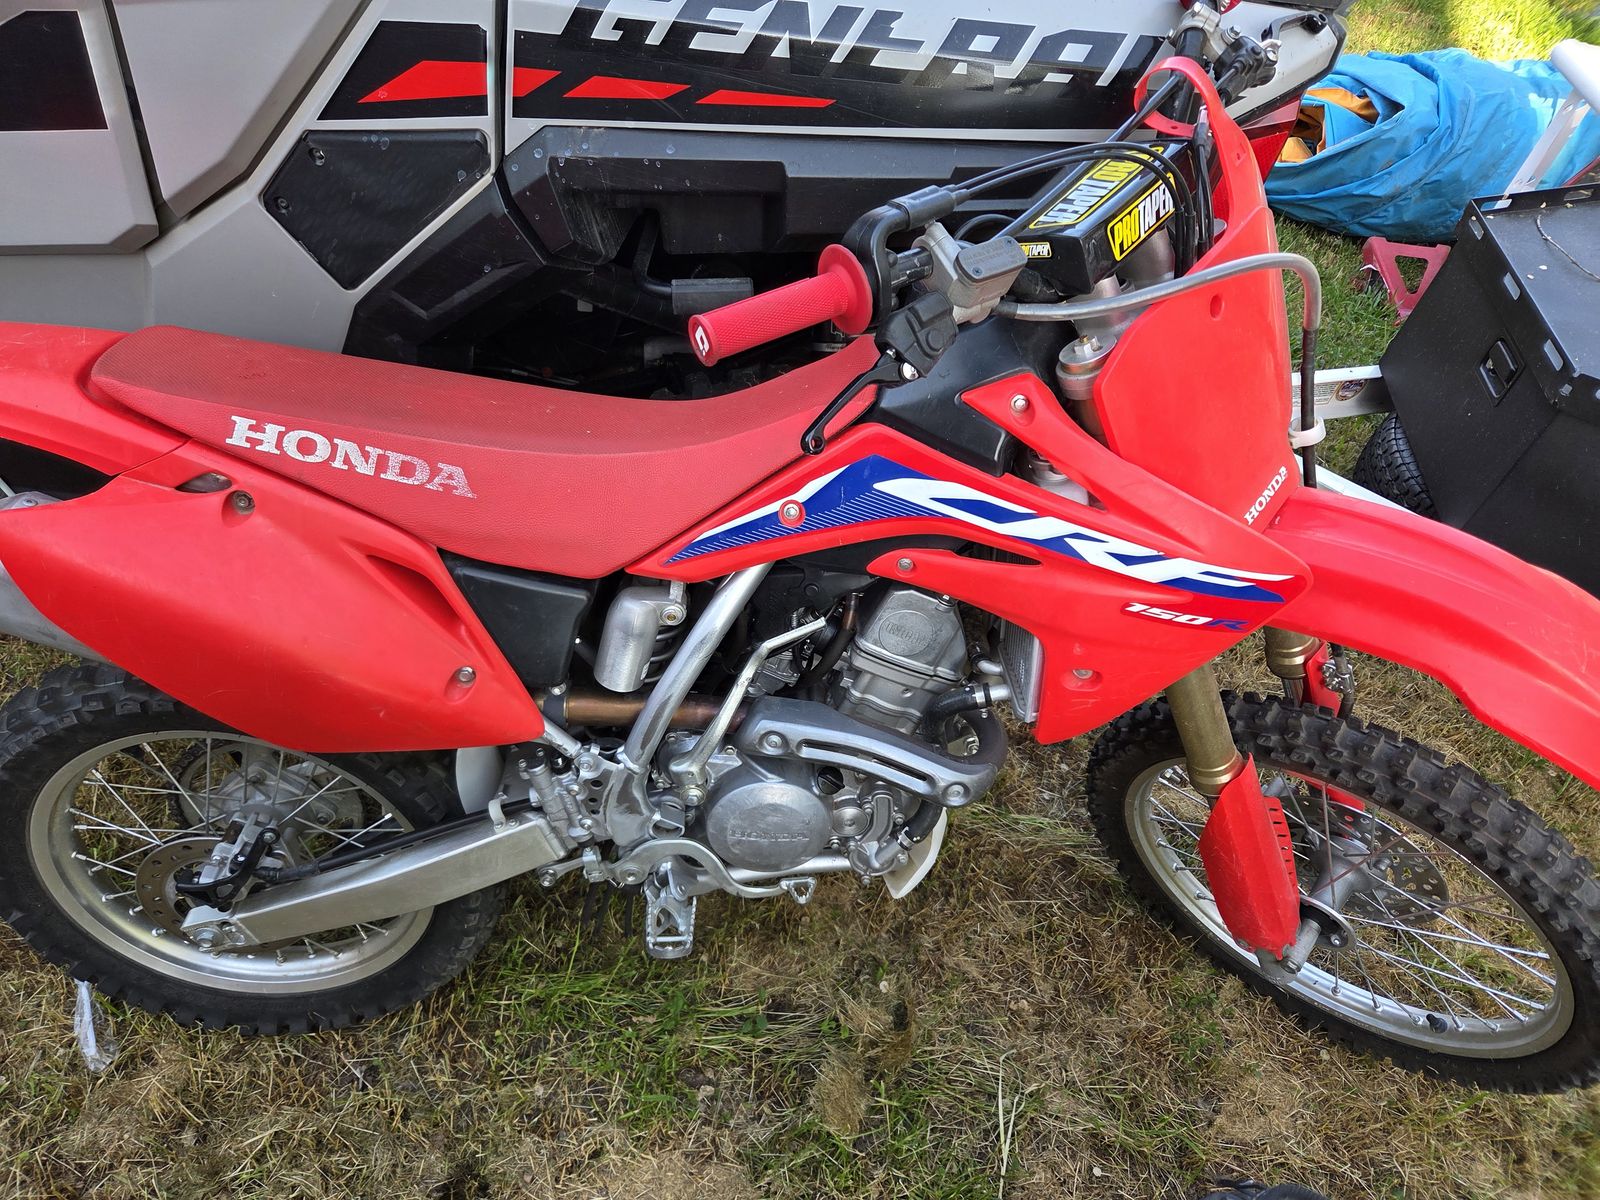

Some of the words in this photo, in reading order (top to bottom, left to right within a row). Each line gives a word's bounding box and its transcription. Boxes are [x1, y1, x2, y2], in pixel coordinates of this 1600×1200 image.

[225, 415, 478, 499] HONDA
[872, 477, 1296, 584] CRF
[1243, 465, 1288, 526] HONDA
[1125, 602, 1250, 632] 150R
